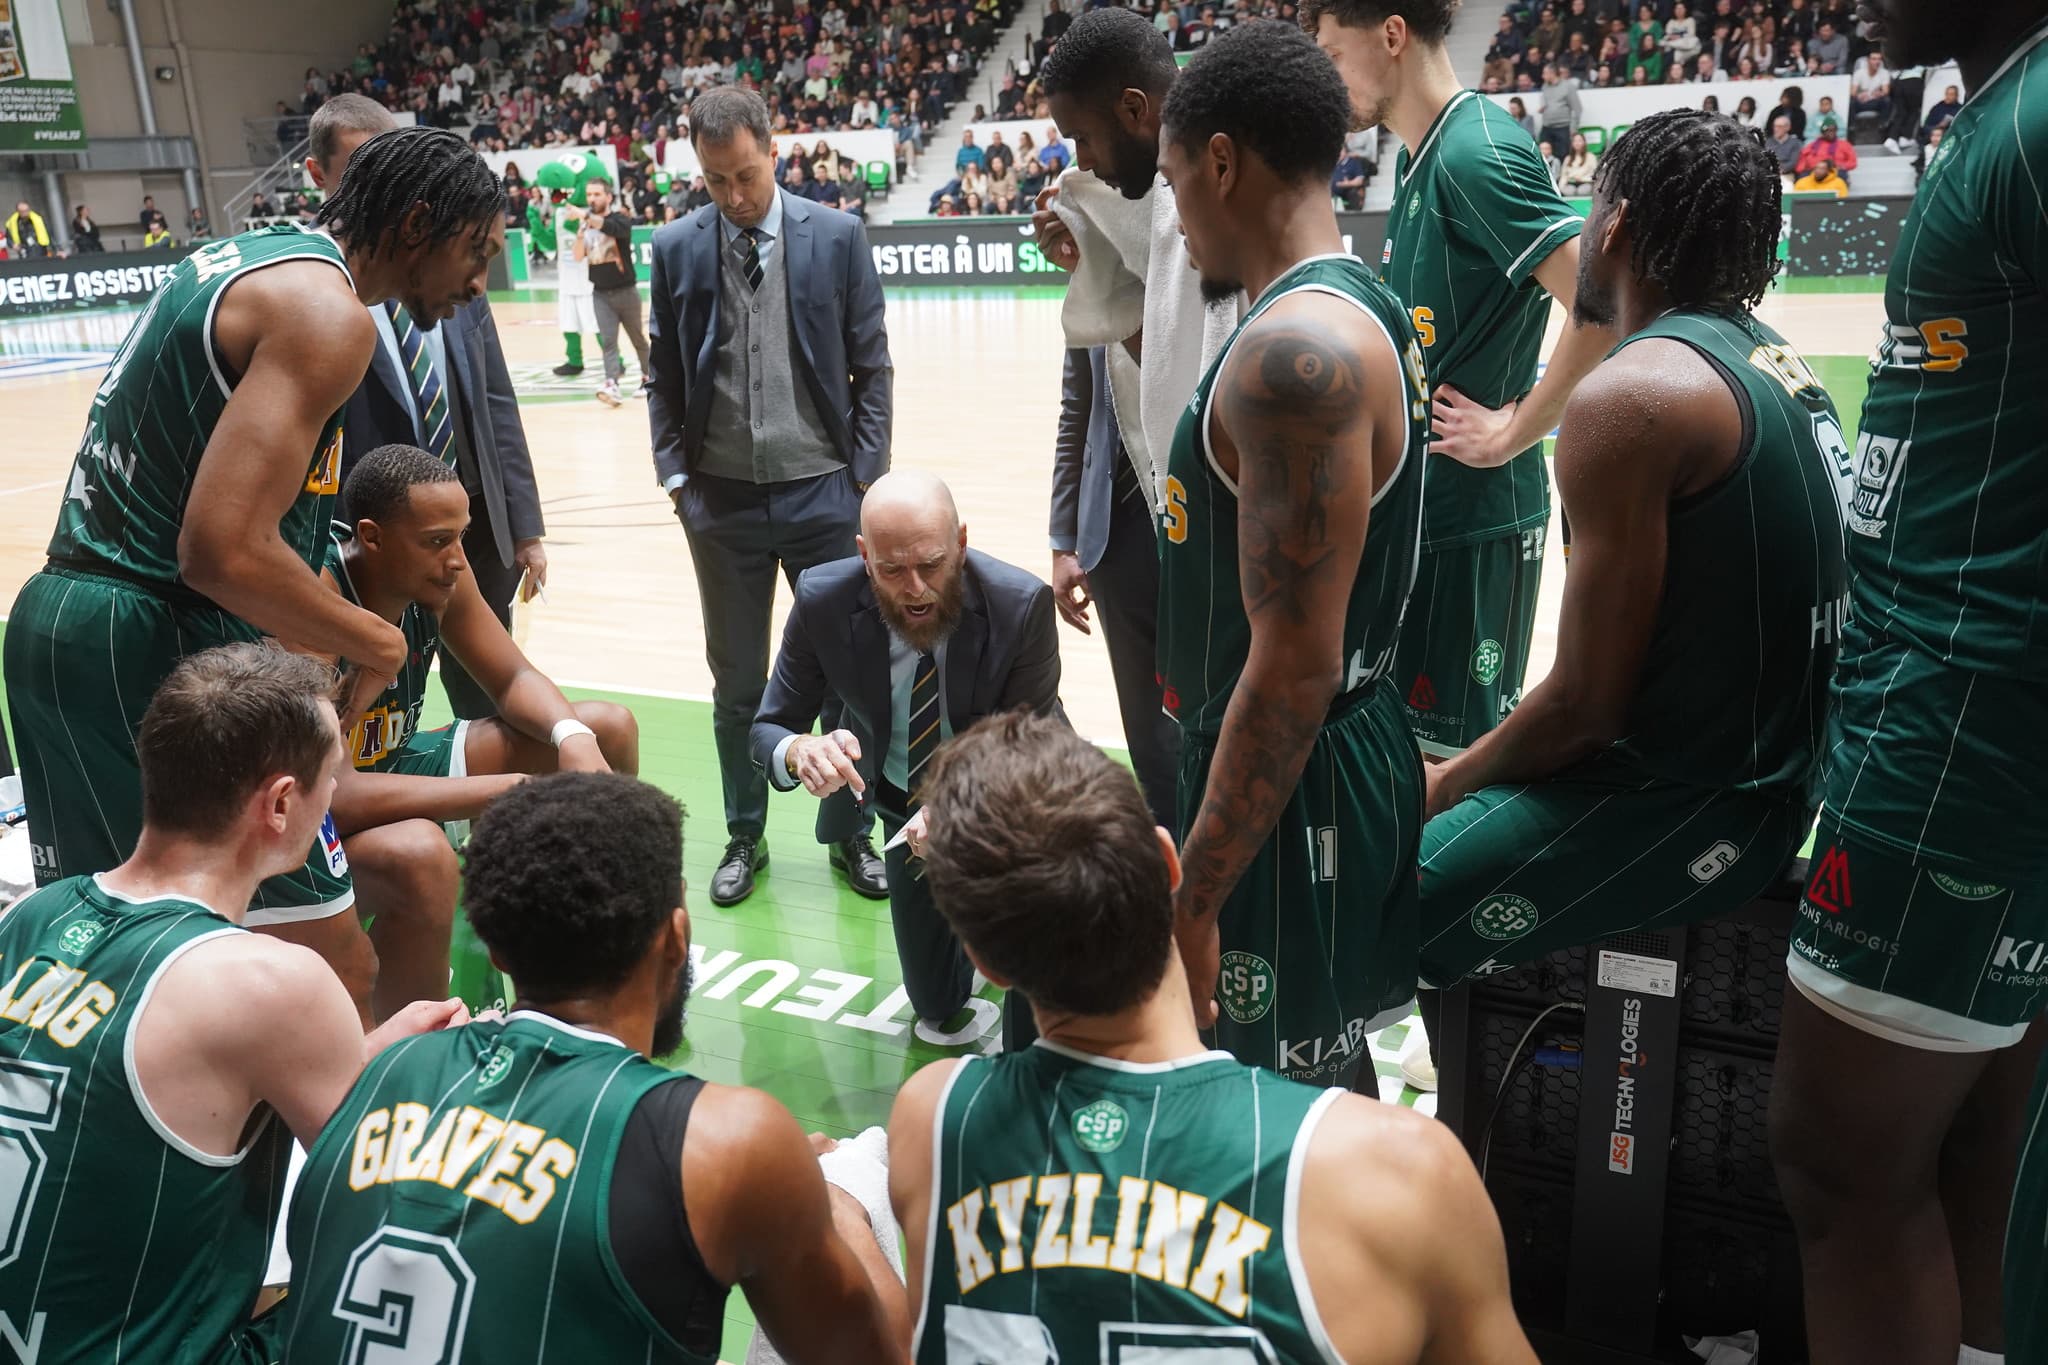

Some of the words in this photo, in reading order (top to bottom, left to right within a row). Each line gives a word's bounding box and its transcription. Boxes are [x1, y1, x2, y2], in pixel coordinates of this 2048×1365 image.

[954, 235, 973, 274] À
[978, 243, 1014, 273] UN
[1476, 648, 1499, 672] CSP
[1481, 902, 1529, 932] CSP
[1823, 917, 1900, 957] ARLOGIS
[1223, 953, 1265, 971] LIMOGES
[1221, 965, 1268, 1001] CSP
[1076, 1111, 1123, 1140] CSP
[349, 1101, 577, 1224] GRAVES
[1613, 1135, 1631, 1169] JSG
[946, 1172, 1273, 1319] KYZLINK
